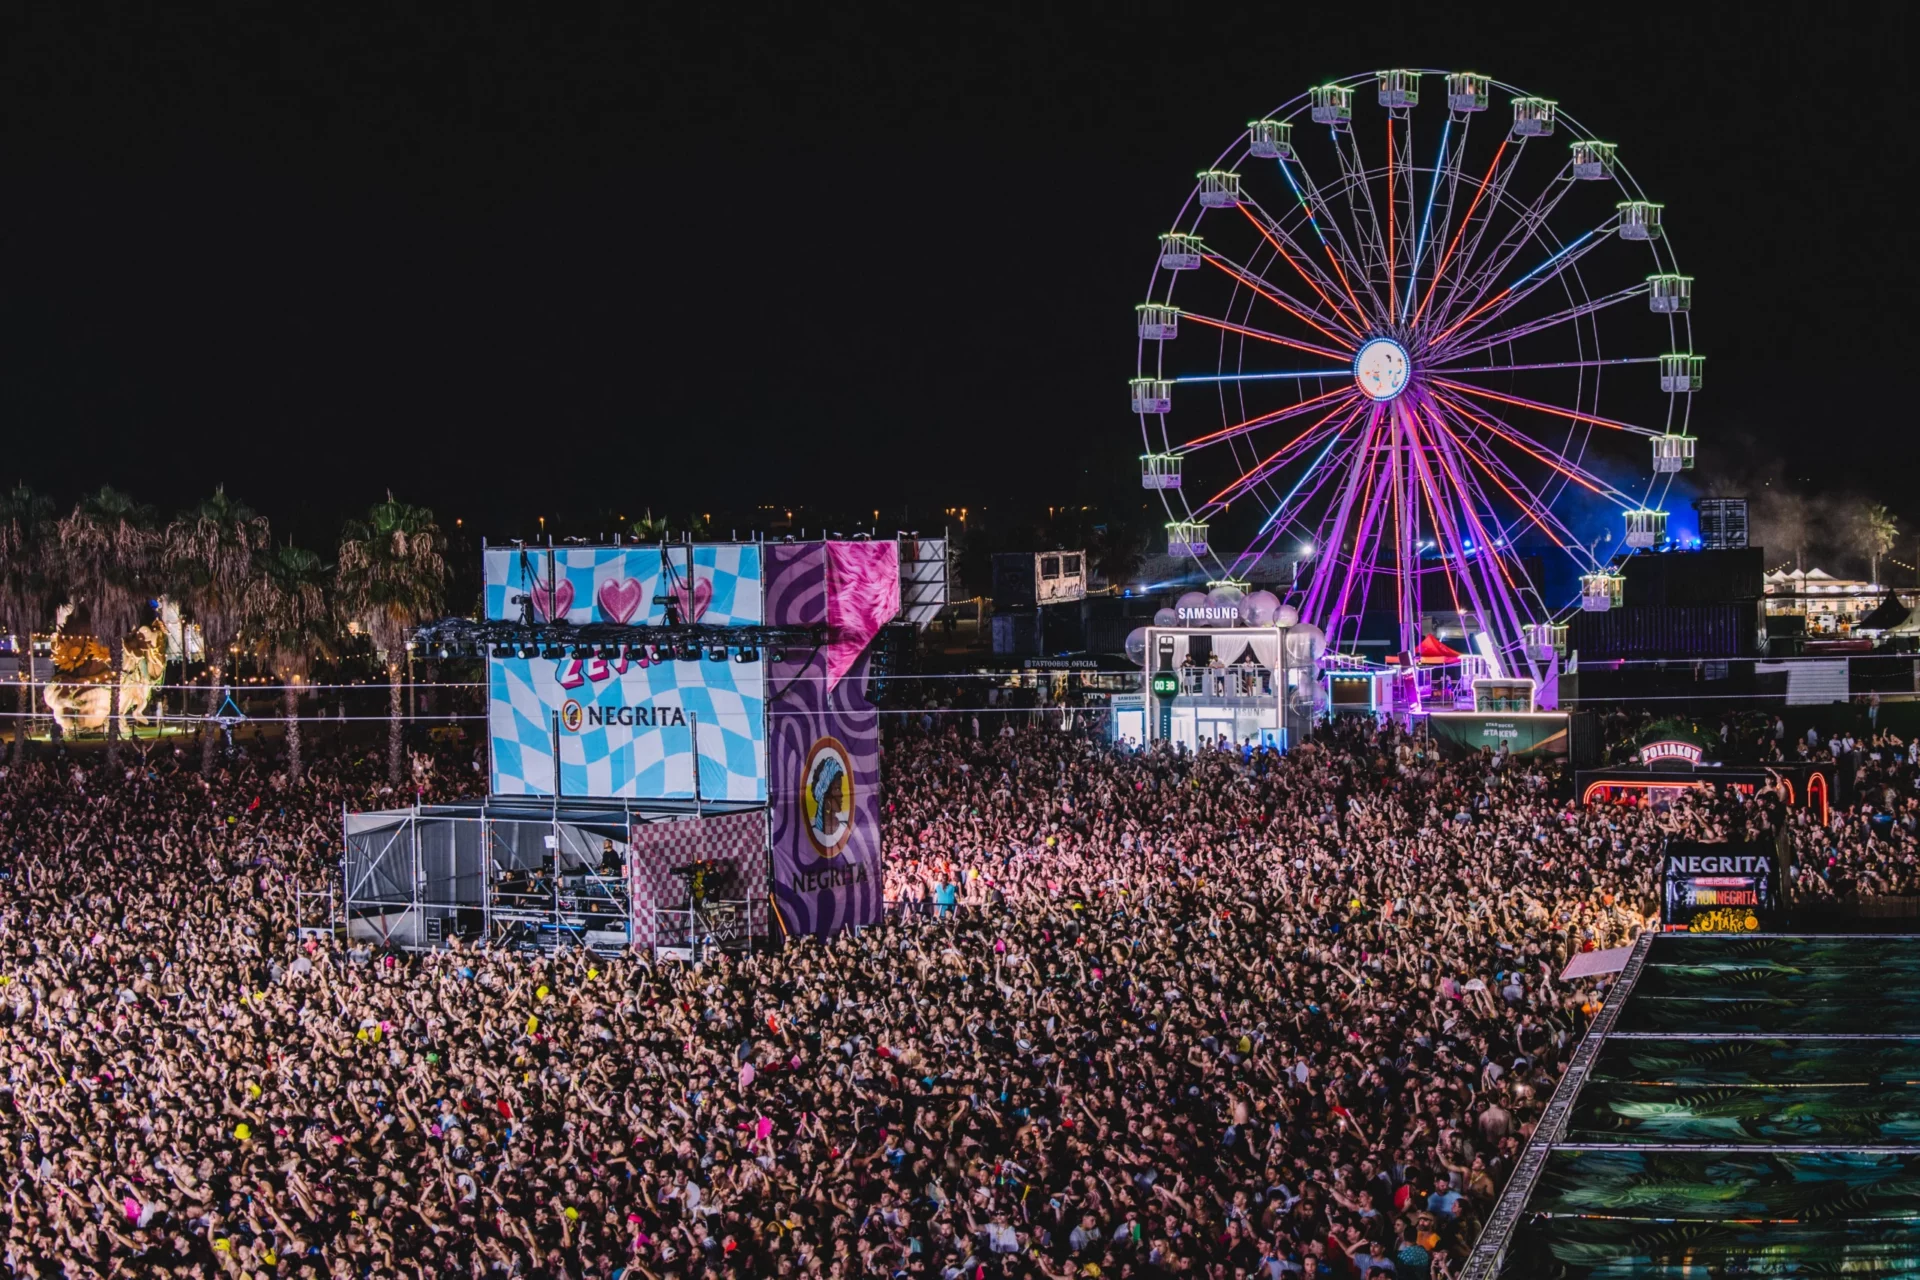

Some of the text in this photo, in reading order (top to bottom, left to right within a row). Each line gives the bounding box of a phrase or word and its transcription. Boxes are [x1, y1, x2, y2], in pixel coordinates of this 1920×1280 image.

[1178, 607, 1239, 619] SAMSUNG
[588, 706, 687, 726] NEGRITA
[1643, 743, 1700, 761] POLIAKOV
[1670, 856, 1771, 873] NEGRITA
[792, 863, 868, 892] NEGRITA
[1686, 890, 1759, 905] #RONNEGRITA
